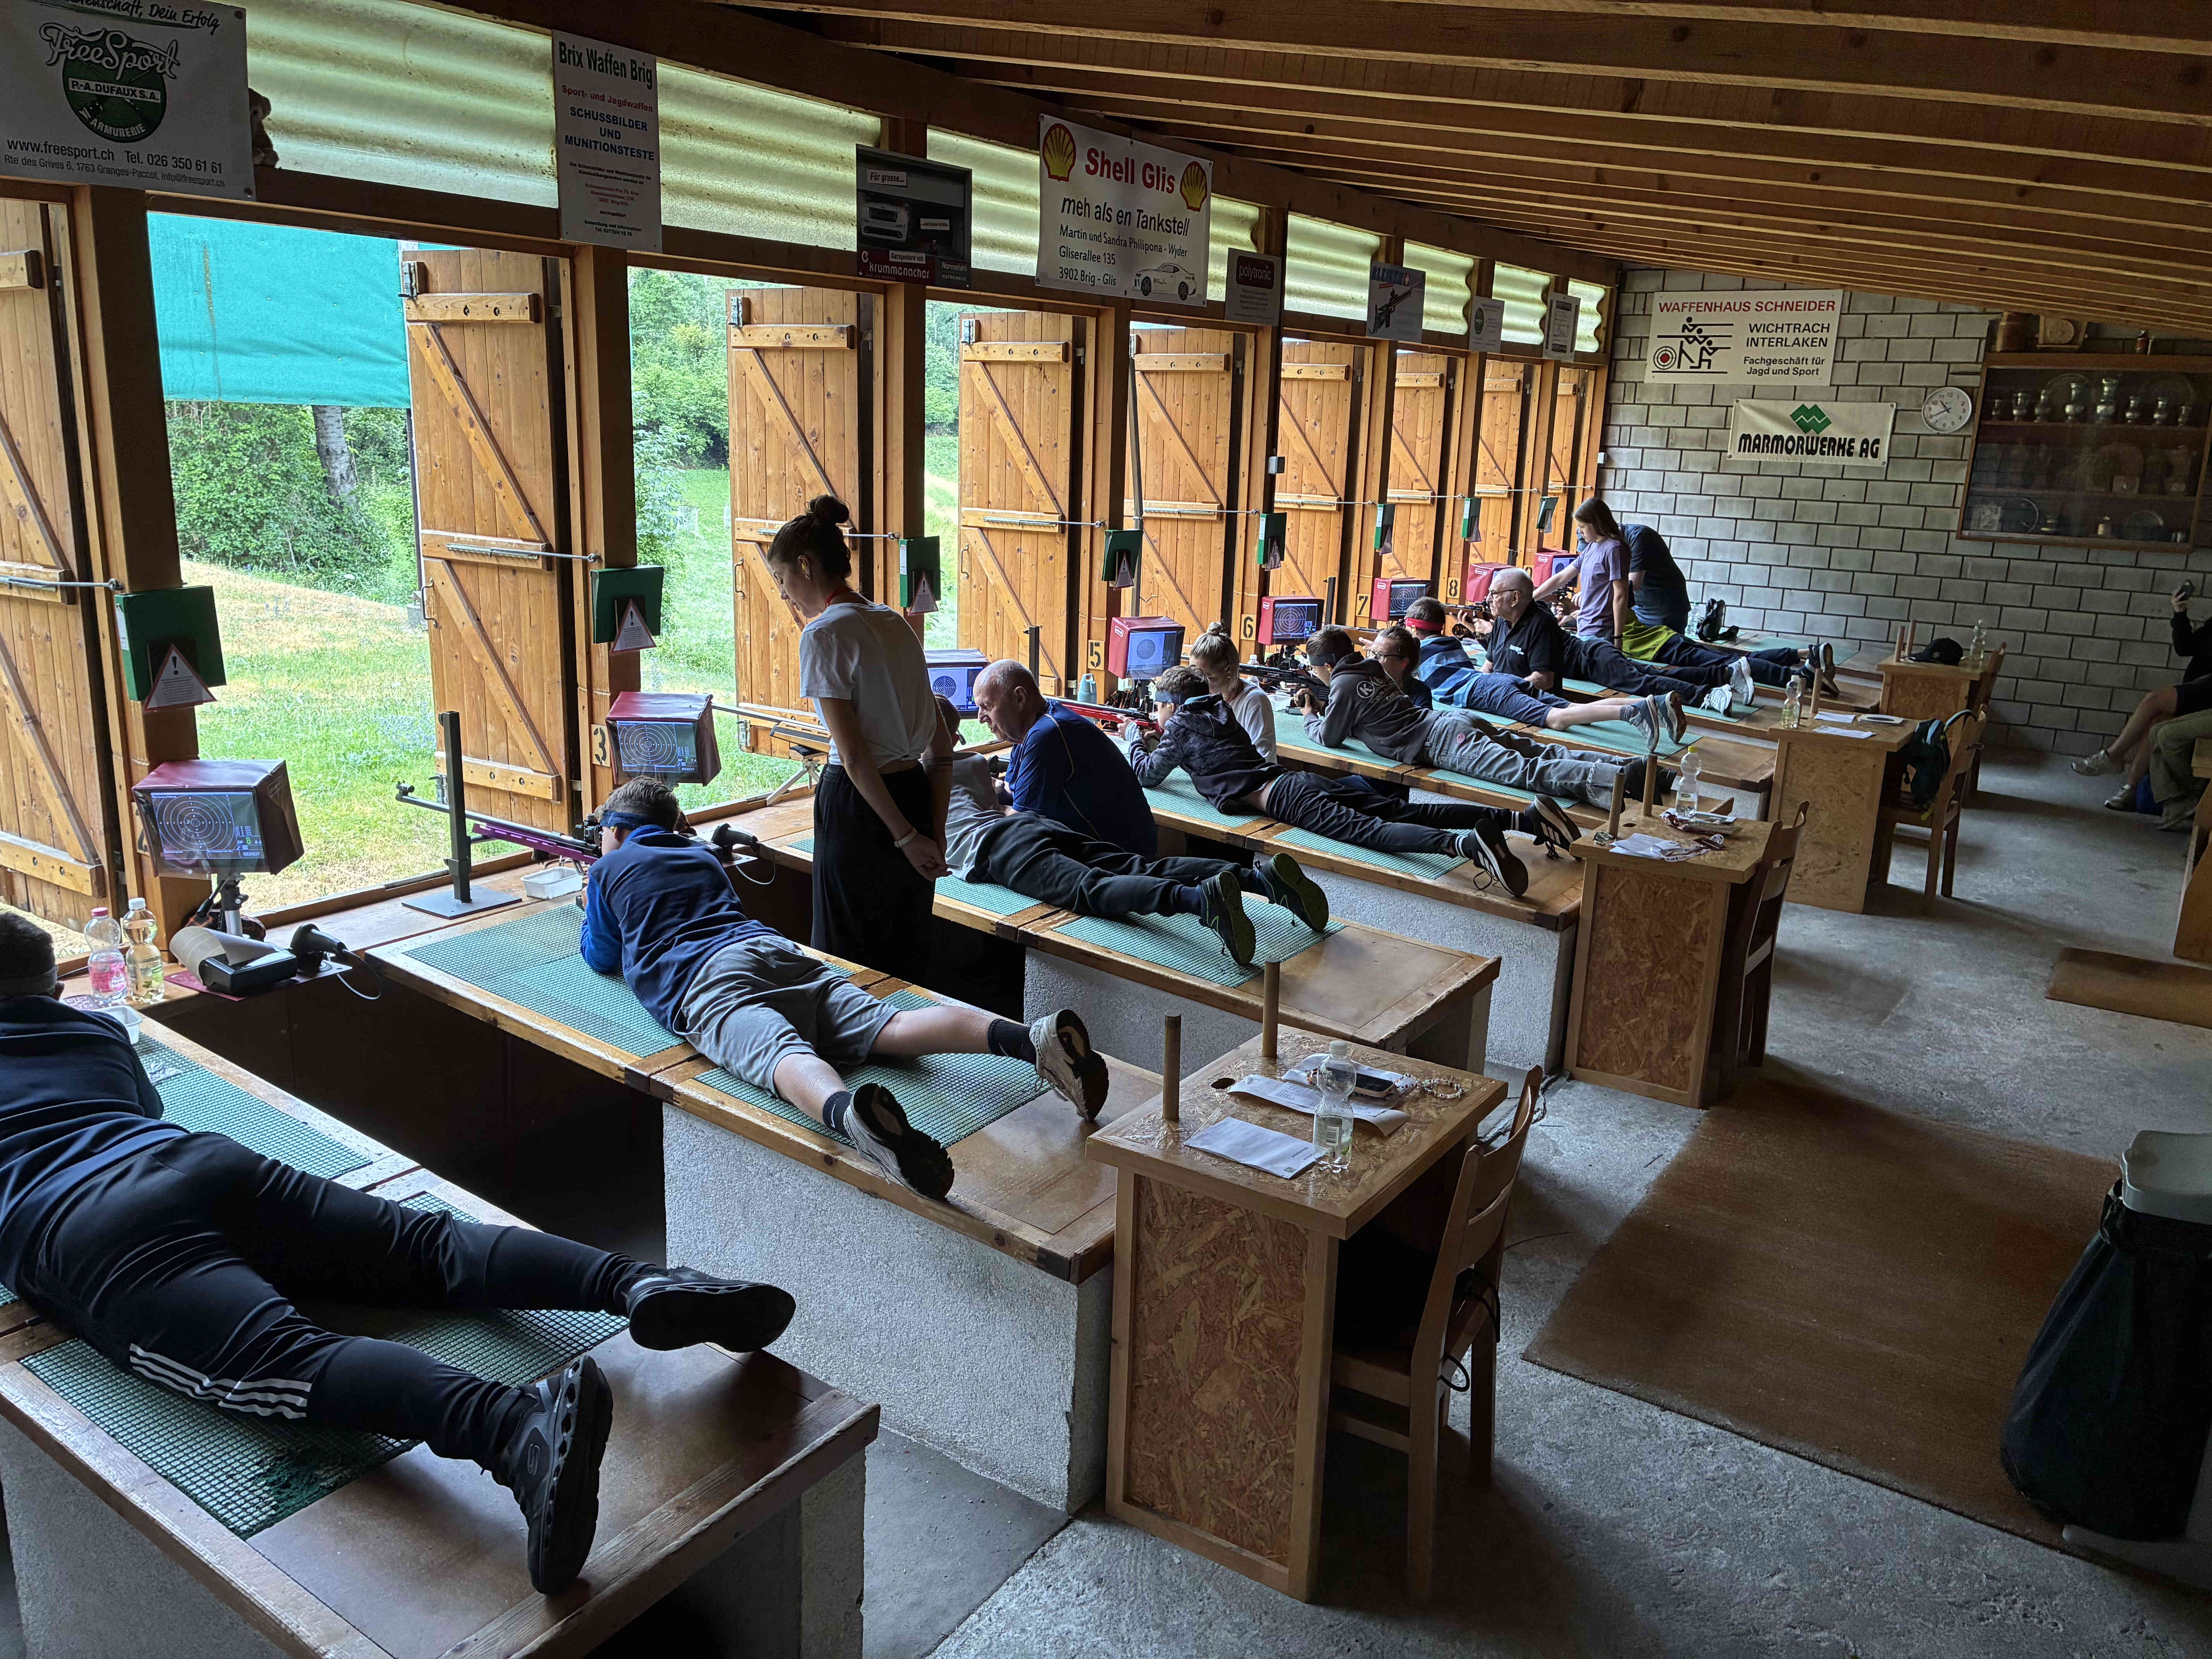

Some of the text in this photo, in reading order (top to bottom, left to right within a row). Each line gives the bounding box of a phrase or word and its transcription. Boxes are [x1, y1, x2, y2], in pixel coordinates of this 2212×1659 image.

[149, 4, 177, 21] Dein
[182, 10, 220, 35] Erfolg
[39, 22, 180, 80] FreeSport
[559, 41, 653, 90] Brix Waffen Brig
[562, 85, 653, 112] Sport- und Jagdwaffen
[91, 118, 146, 137] ARMURERIE
[570, 106, 647, 131] SCHUSSBILDER
[599, 127, 621, 140] UND
[7, 139, 222, 173] www.freesport.ch Tel. 026 350 61 61
[565, 135, 654, 161] MUNITIONSTESTE
[5, 155, 18, 164] Rte
[21, 157, 36, 166] des
[40, 158, 64, 169] Grives
[77, 163, 94, 173] 1763
[1085, 148, 1175, 194] Shell Glis
[871, 172, 880, 180] Für
[1061, 197, 1190, 236] meh als en Tankstell
[1060, 224, 1087, 240] Martin
[1089, 231, 1102, 243] und
[1104, 232, 1127, 247] Sandra
[1129, 237, 1162, 254] Philipona
[1169, 244, 1187, 259] Wyder
[1059, 246, 1116, 265] Gliserallee 135
[869, 261, 929, 279] krummenacher
[1059, 267, 1078, 281] 3902
[1080, 270, 1095, 287] Brig
[1103, 273, 1116, 286] Glis
[1239, 264, 1271, 281] polytronic
[1659, 300, 1836, 313] WAFFENHAUS SCHNEIDER
[1748, 323, 1830, 333] WICHTRACH
[1746, 337, 1828, 348] INTERLAKEN
[1743, 356, 1826, 366] Fachgeschäft für
[1747, 367, 1769, 377] Jagd
[1792, 367, 1819, 377] Sport
[1738, 433, 1880, 459] MARMORWERKE AG
[1449, 579, 1458, 596] 8
[1358, 596, 1368, 615] 7
[1243, 616, 1253, 638] 6
[1090, 642, 1101, 668] 5
[593, 727, 606, 765] 3
